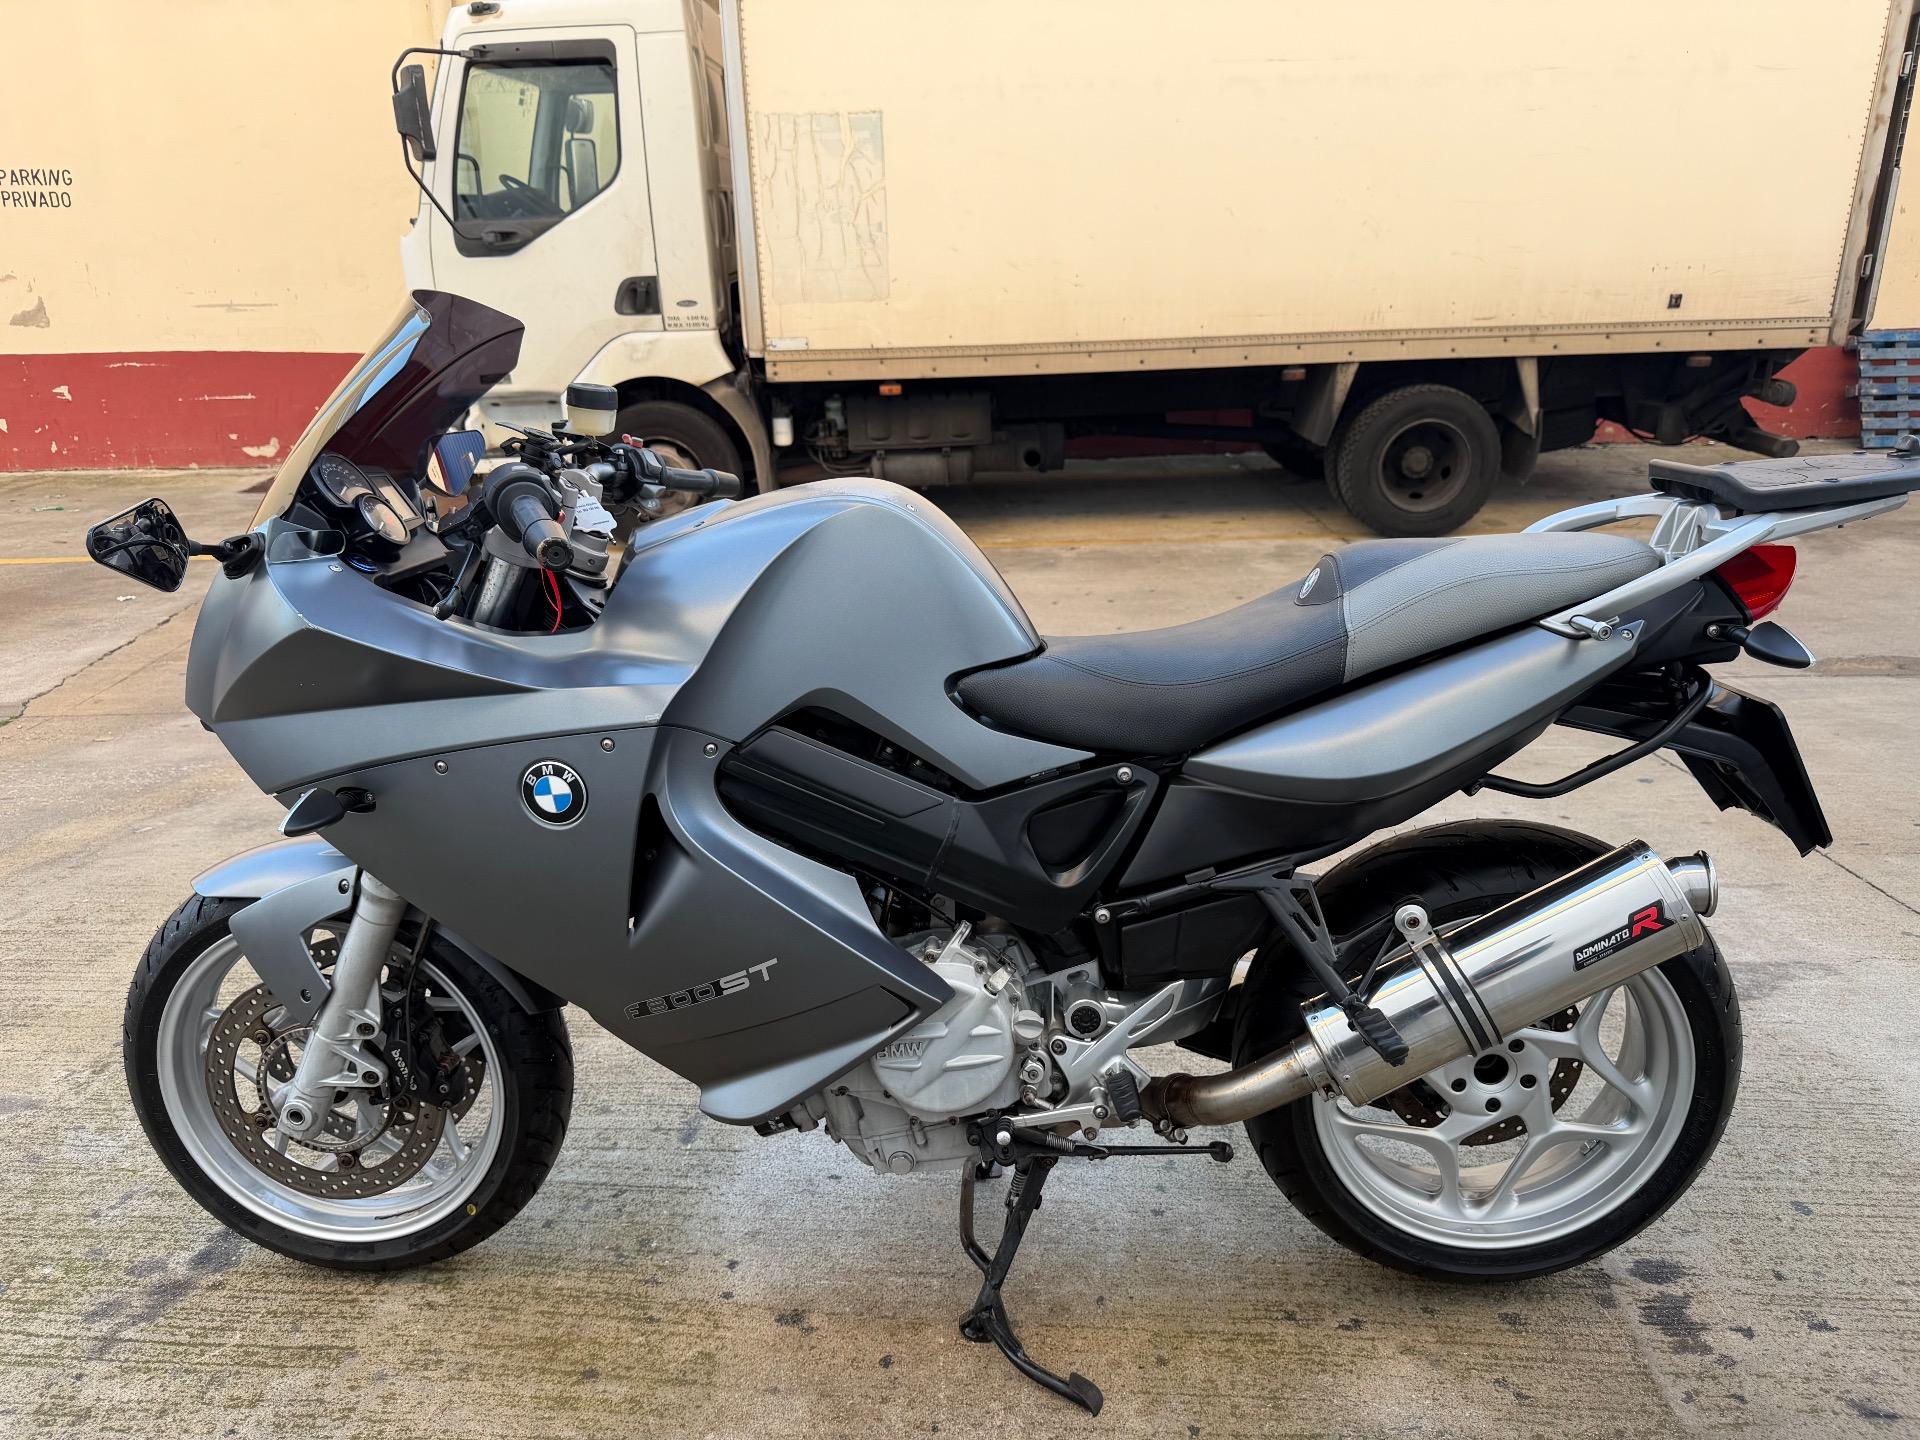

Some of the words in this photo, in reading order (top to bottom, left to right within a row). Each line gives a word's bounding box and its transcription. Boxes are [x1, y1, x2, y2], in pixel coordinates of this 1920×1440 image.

[0, 168, 73, 186] PARKING
[1, 190, 72, 208] PRIVADO
[525, 764, 576, 787] BMW
[876, 1043, 923, 1060] BMW
